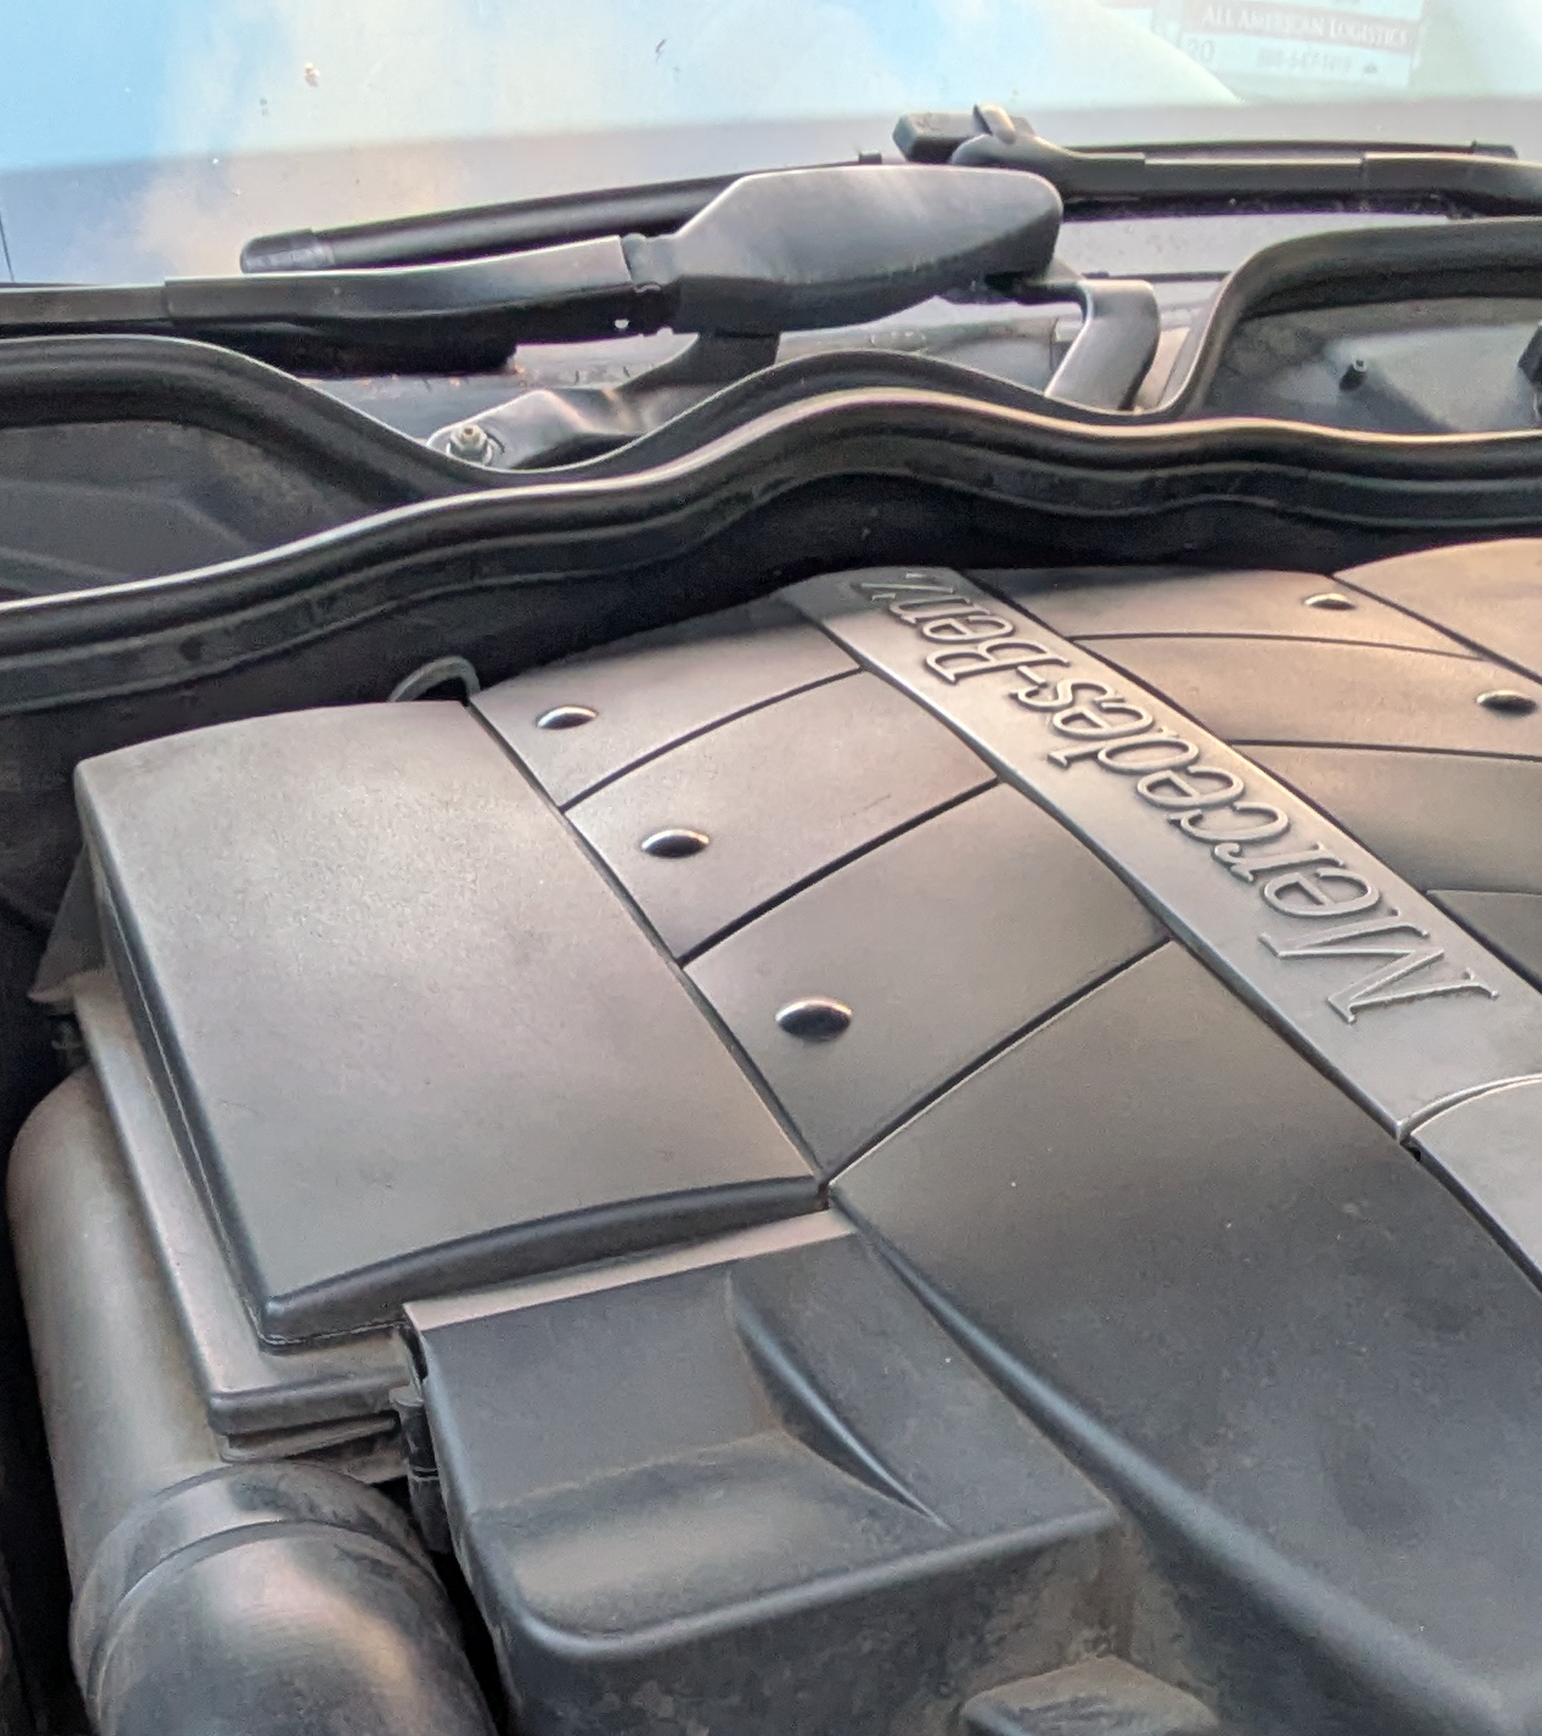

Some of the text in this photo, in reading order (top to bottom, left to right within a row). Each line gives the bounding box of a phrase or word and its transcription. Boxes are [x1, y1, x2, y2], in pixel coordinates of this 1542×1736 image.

[1239, 10, 1325, 37] AMERICAN
[1330, 18, 1410, 48] LOGISTICS
[859, 571, 1501, 1025] Mercedes-Benz
